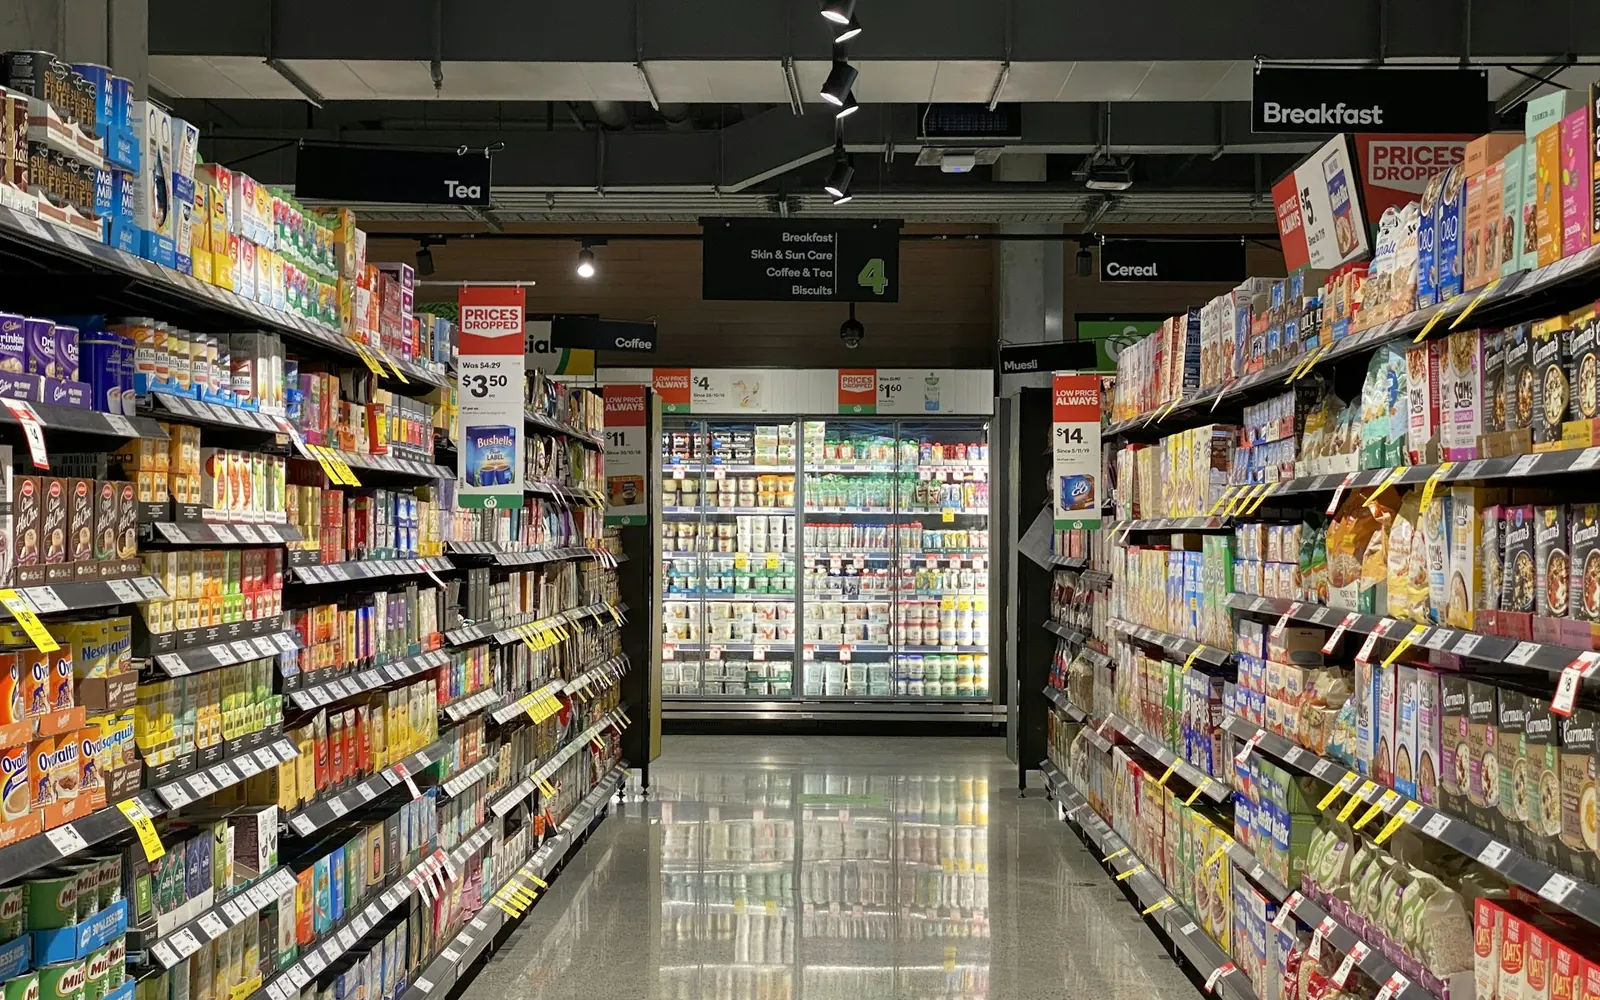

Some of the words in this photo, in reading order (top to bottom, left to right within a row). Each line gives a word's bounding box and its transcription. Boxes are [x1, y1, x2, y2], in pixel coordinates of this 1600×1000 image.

[1263, 102, 1384, 124] Breakfast
[1373, 146, 1464, 165] PRICES
[444, 180, 481, 199] Tea
[782, 232, 833, 242] Breakfast
[751, 250, 773, 260] Skin
[775, 250, 783, 260] &
[785, 250, 805, 260] Sun
[807, 251, 833, 260] Care
[766, 267, 800, 277] Coffee
[802, 268, 811, 277] &
[812, 268, 832, 278] Tea
[1106, 262, 1158, 276] Cereal
[858, 258, 888, 295] 4
[792, 285, 832, 295] Biscuits
[465, 308, 518, 320] PRICES
[465, 321, 518, 330] DROPPED
[615, 337, 652, 349] Coffee
[1004, 359, 1038, 371] Muesli
[693, 376, 709, 390] $4
[1056, 397, 1098, 406] ALWAYS
[477, 435, 512, 448] Bushells
[606, 432, 625, 446] $11
[1057, 428, 1083, 444] $14
[1476, 926, 1490, 948] OATS
[1503, 940, 1521, 965] OATS
[1529, 956, 1545, 979] OATS
[1552, 972, 1571, 1000] OATS
